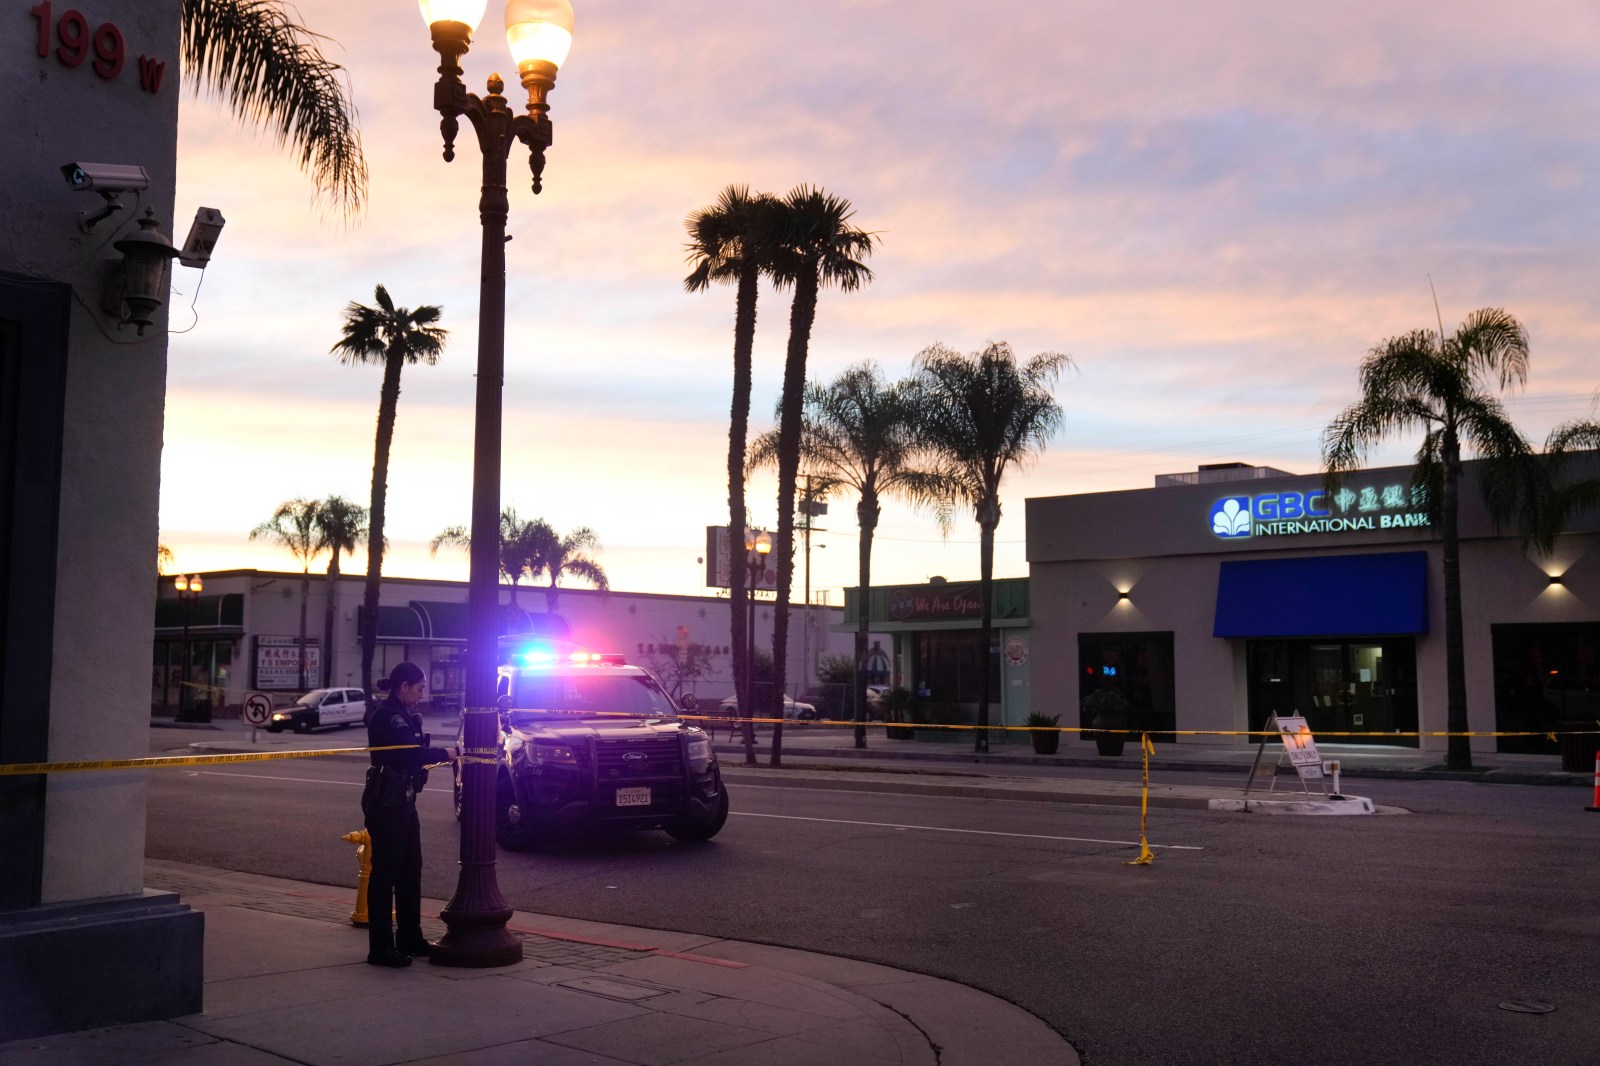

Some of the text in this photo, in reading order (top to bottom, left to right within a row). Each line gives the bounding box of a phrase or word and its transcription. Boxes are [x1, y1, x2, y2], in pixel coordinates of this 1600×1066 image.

[30, 0, 125, 80] 199
[1252, 489, 1331, 520] GBC
[1256, 512, 1431, 536] INTERNATIONAL BANK
[915, 596, 930, 612] We
[932, 595, 950, 612] Are
[954, 595, 982, 614] Open
[1290, 750, 1317, 760] ONLY ONLY
